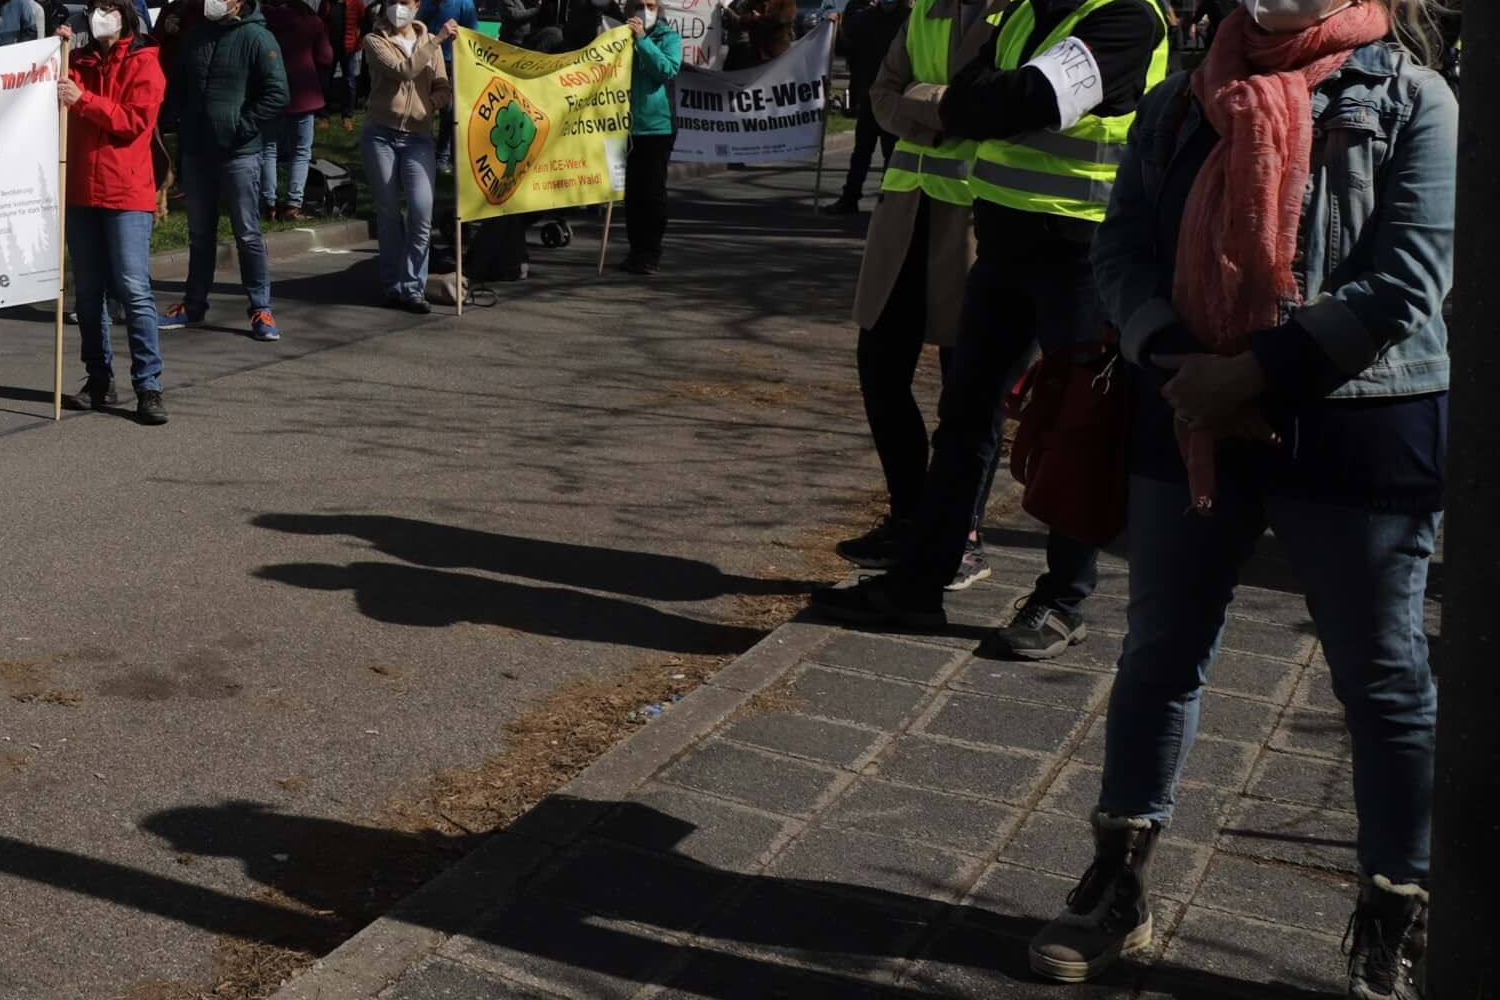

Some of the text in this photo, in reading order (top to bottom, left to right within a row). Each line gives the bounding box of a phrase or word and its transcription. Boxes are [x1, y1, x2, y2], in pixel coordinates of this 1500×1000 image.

[680, 88, 723, 112] zum
[676, 115, 739, 132] unserem
[550, 158, 588, 172] ICE-Werk
